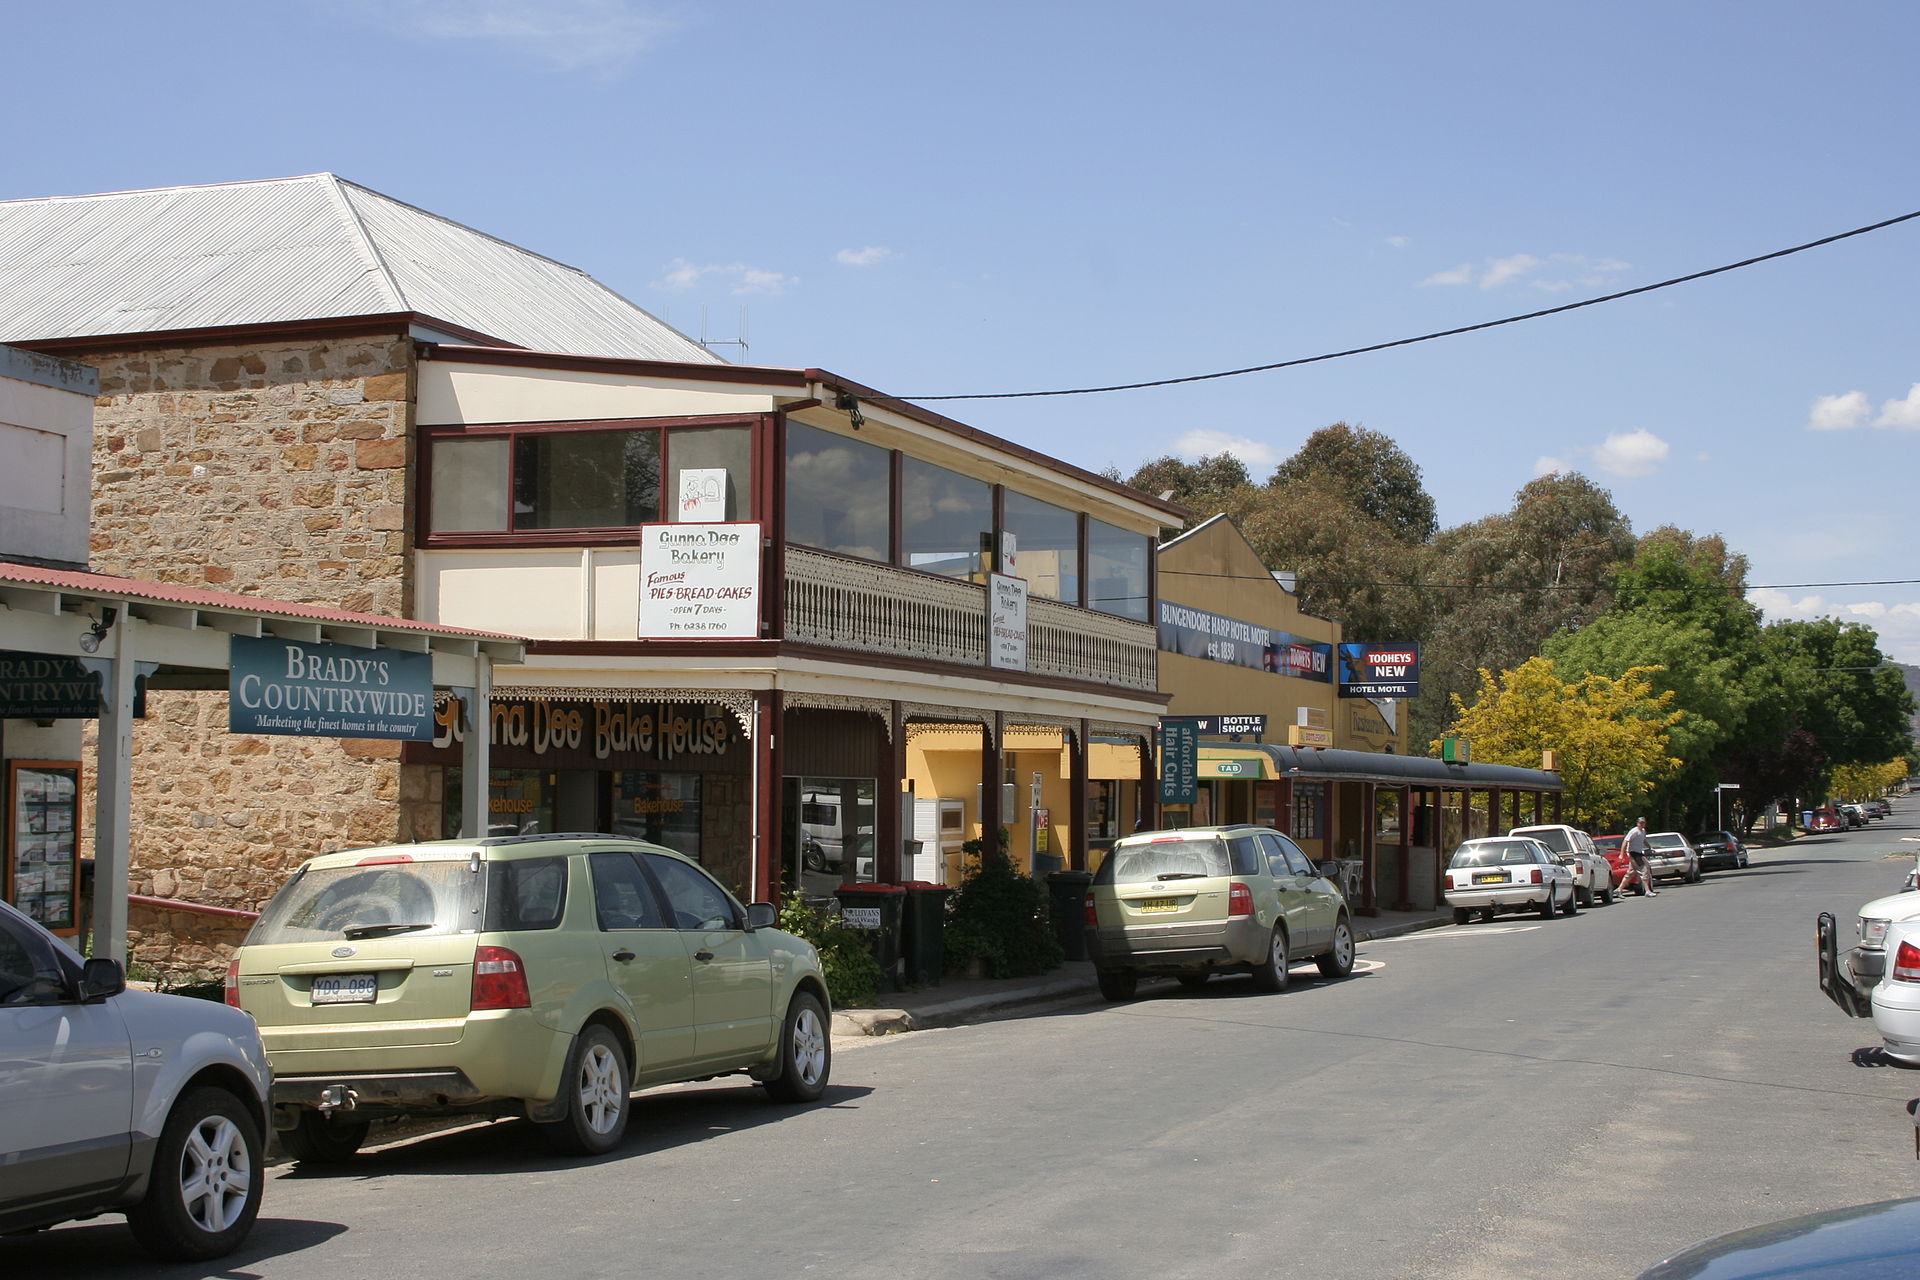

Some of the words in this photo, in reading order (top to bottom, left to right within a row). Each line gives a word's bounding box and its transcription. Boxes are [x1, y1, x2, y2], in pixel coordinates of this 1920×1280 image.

[708, 531, 740, 546] Doo
[671, 549, 724, 570] Bakery
[647, 571, 685, 587] Famous
[694, 604, 703, 615] 7
[708, 622, 727, 630] 1760
[1161, 603, 1211, 633] BUNGENDORE
[1211, 617, 1230, 637] HARP
[1231, 620, 1250, 642] HOTEL
[1251, 625, 1271, 648] MOTEL
[1207, 642, 1220, 658] est.
[1221, 642, 1235, 661] 1838
[1368, 654, 1412, 663] TOOHEYS
[285, 645, 390, 686] BRADY'S
[1312, 652, 1326, 673] NEW
[1375, 666, 1406, 677] NEW
[239, 674, 426, 718] COUNTRYWIDE
[303, 717, 317, 730] the
[317, 716, 339, 733] finest
[341, 718, 365, 731] homes
[367, 720, 376, 731] in
[376, 720, 389, 732] the
[533, 699, 583, 754] Doo
[594, 701, 653, 760] Bake
[658, 704, 727, 760] House
[1222, 725, 1250, 733] SHOP
[1223, 717, 1261, 725] BOTTLE
[1165, 727, 1178, 759] Hair
[1181, 727, 1193, 797] affordable
[1164, 762, 1178, 797] Cuts
